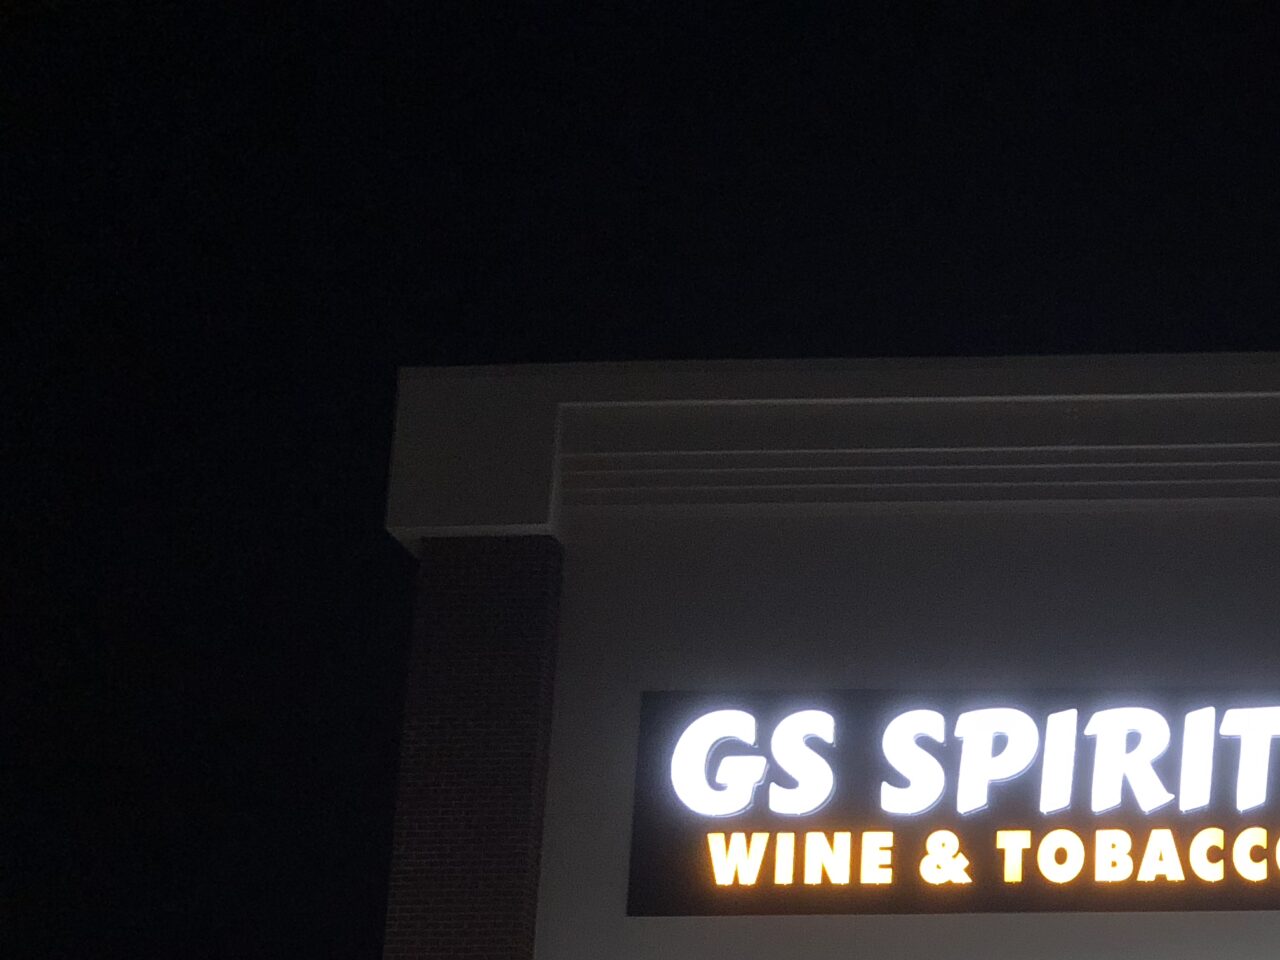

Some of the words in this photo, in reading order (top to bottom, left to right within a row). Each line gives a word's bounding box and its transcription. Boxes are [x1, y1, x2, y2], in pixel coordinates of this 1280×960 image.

[670, 709, 837, 817] GS
[707, 831, 894, 887] WINE
[919, 829, 973, 886] &
